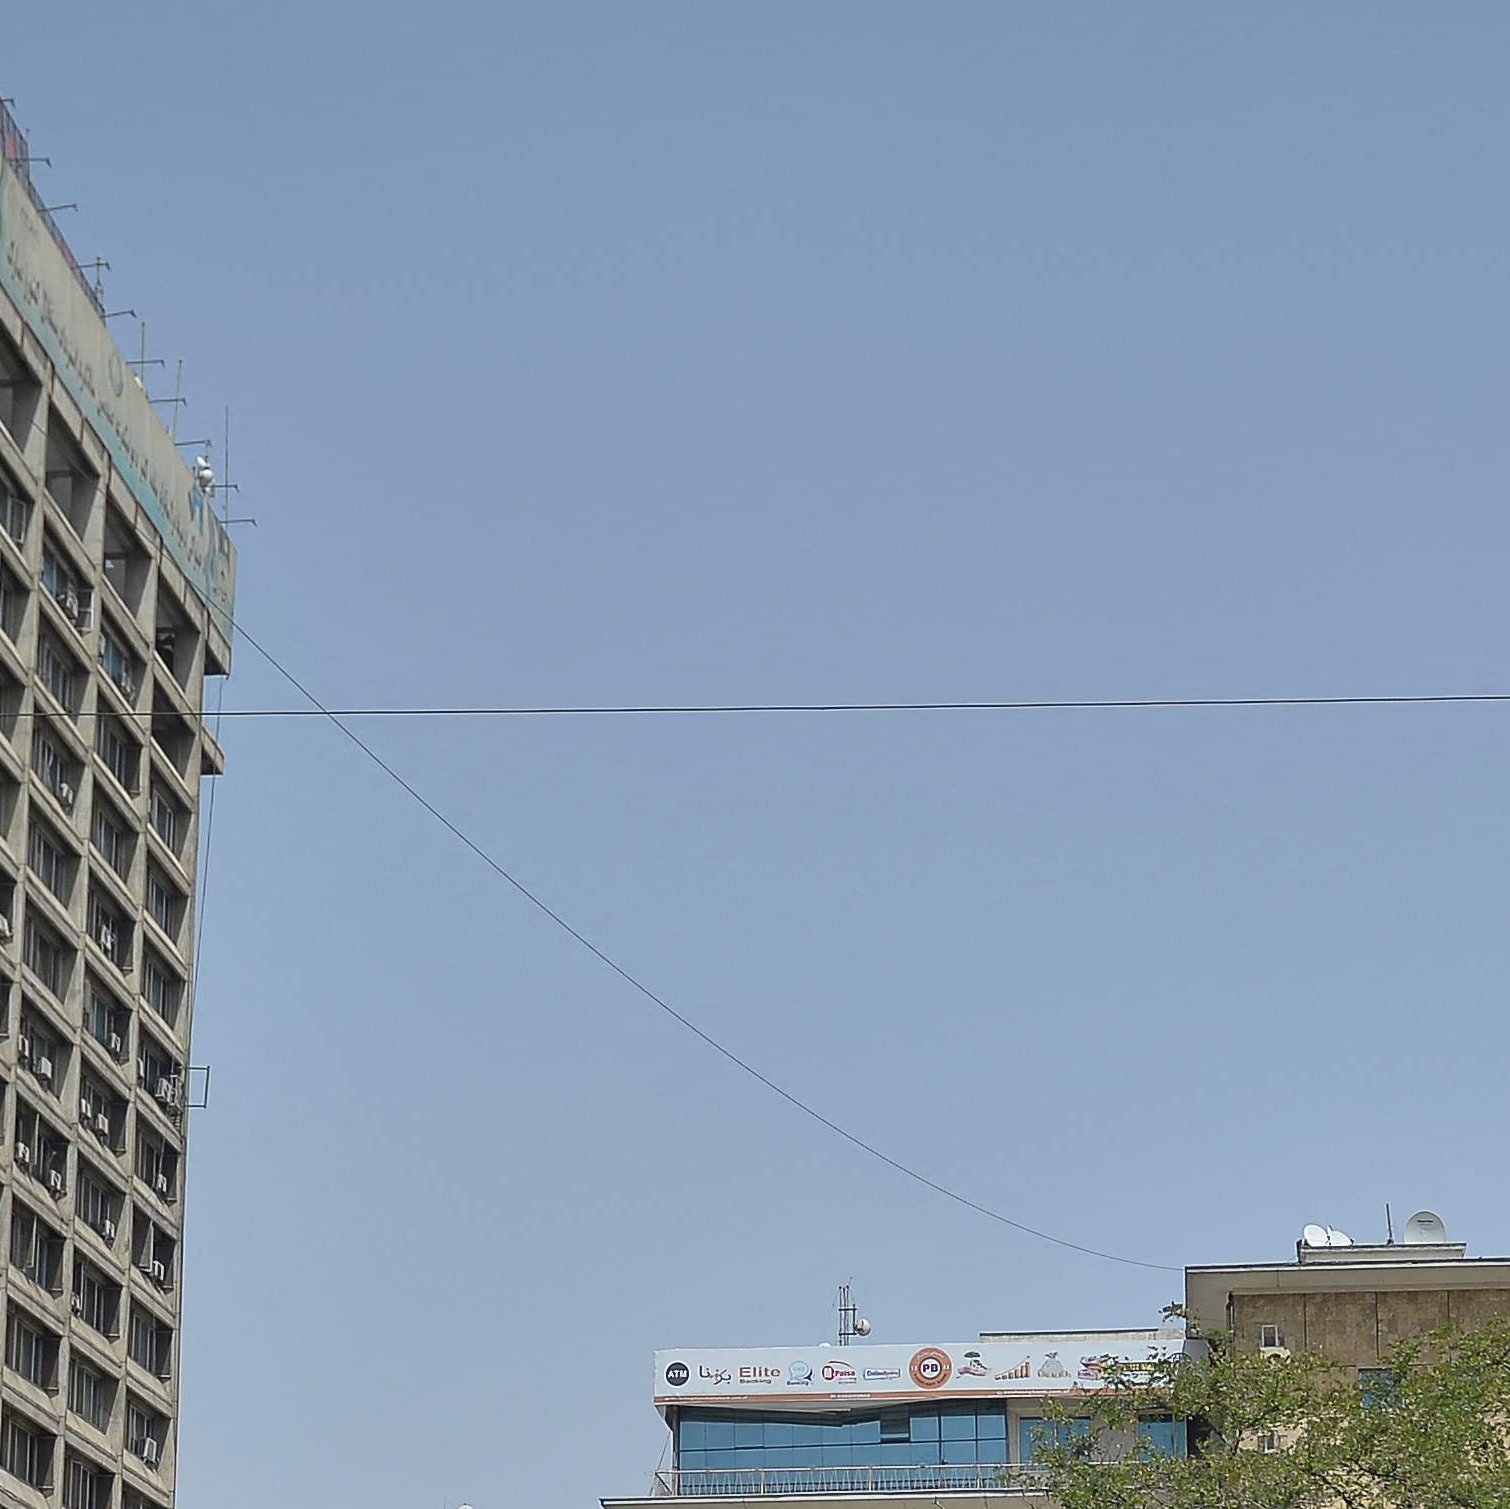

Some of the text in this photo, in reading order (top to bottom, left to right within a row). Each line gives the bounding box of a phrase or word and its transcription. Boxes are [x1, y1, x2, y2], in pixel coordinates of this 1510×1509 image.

[739, 1366, 781, 1378] Elite
[922, 1363, 939, 1373] PB
[667, 1370, 688, 1379] ATM
